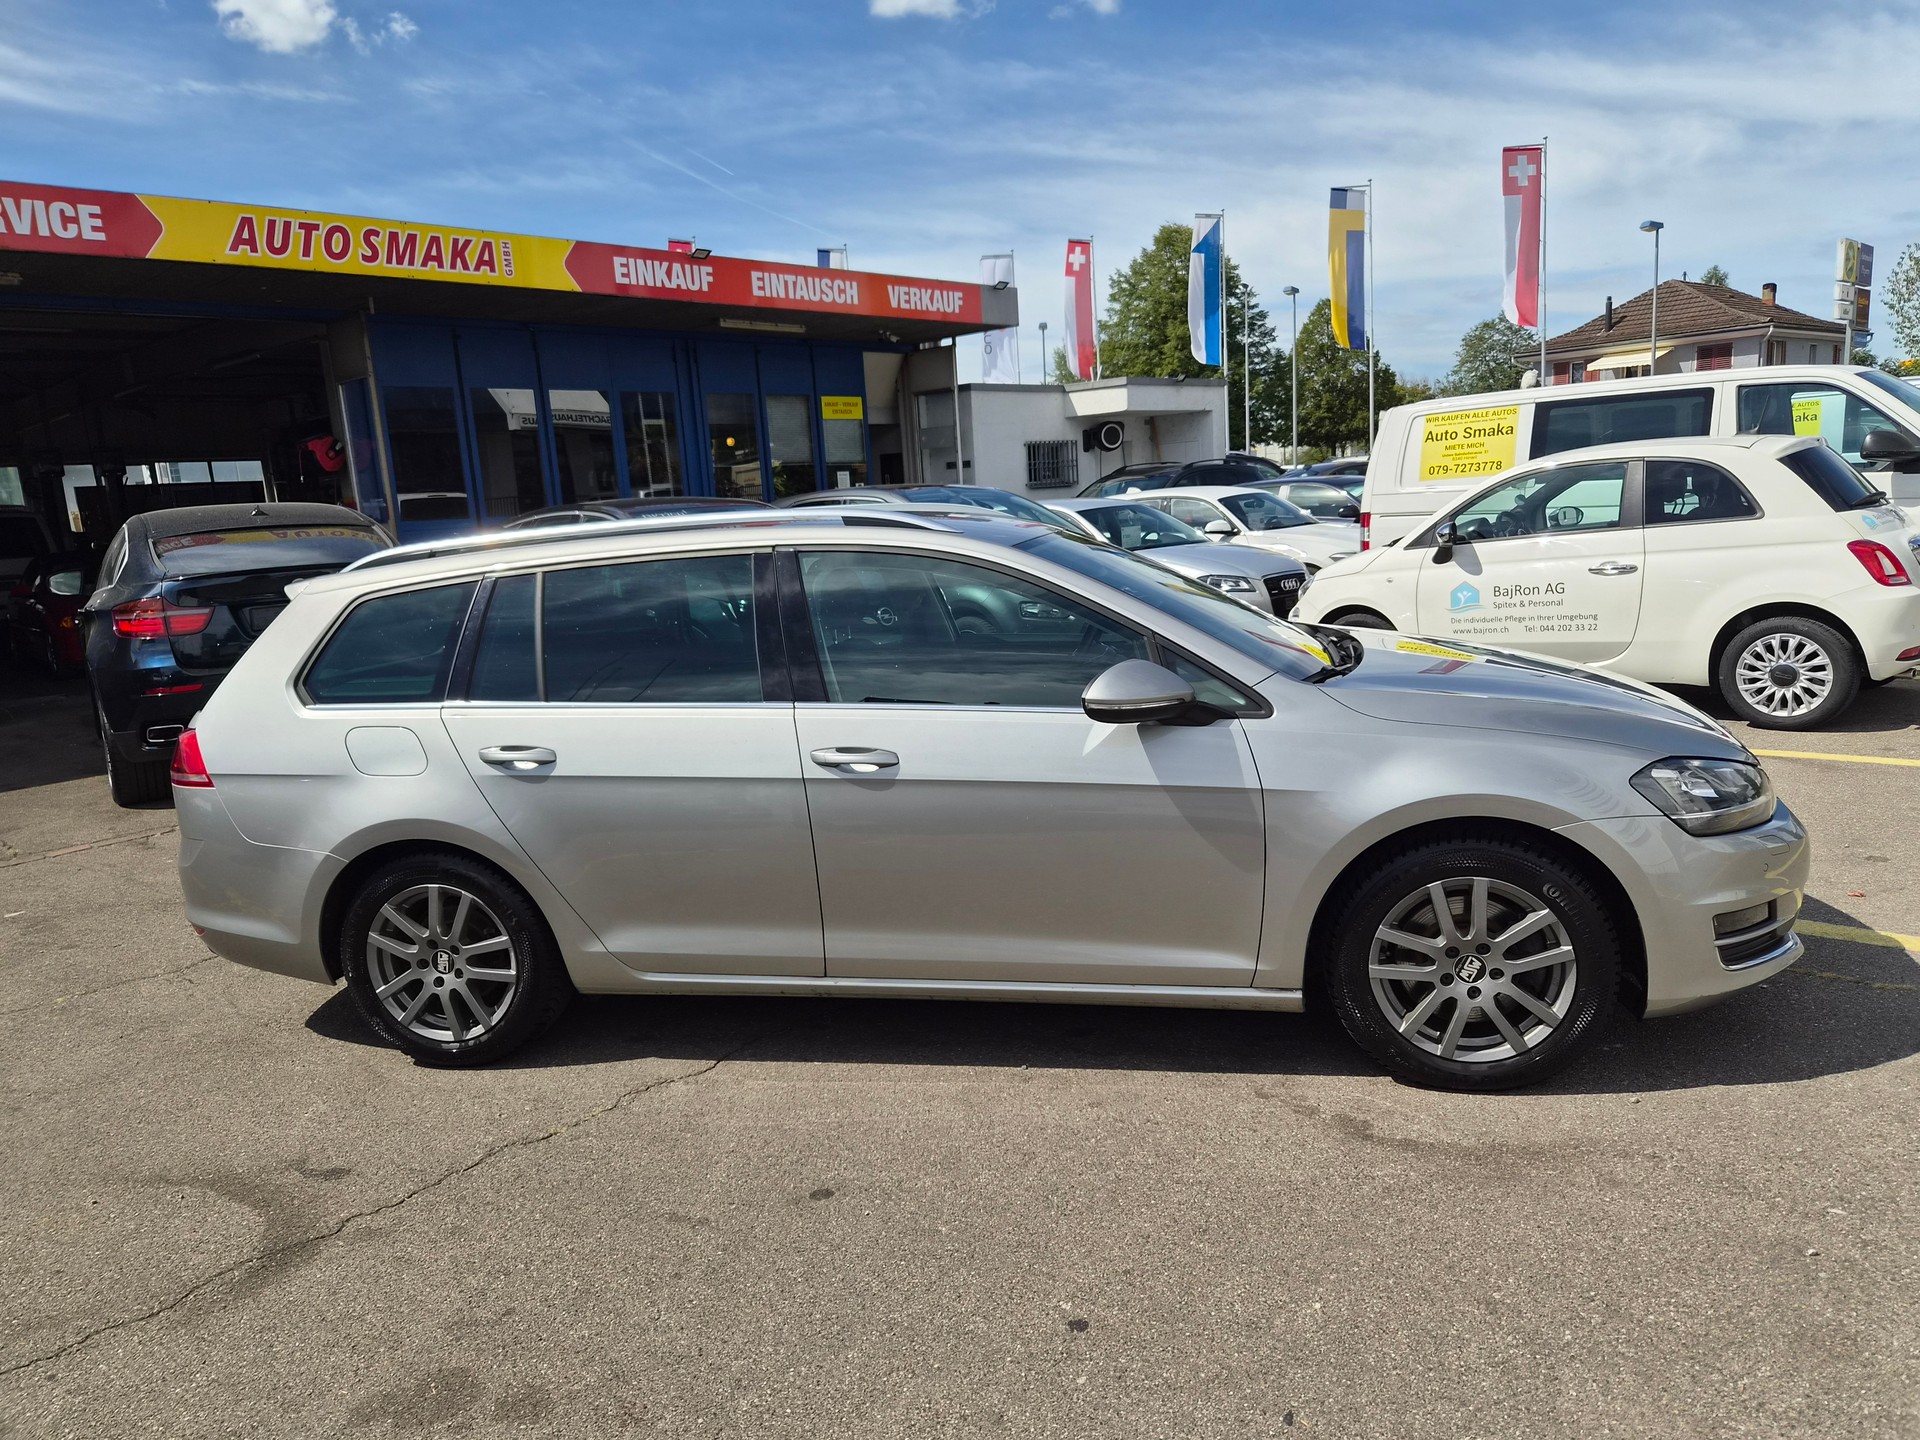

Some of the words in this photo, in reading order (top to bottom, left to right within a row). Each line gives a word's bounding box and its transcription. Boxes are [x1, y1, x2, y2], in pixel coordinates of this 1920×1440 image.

[227, 215, 352, 262] AUTO
[360, 227, 498, 275] SMAKA
[501, 240, 514, 277] GMBH
[613, 256, 713, 292] EINKAUF
[751, 271, 859, 305] EINTAUSCH
[887, 284, 963, 314] VERKAUF
[1426, 416, 1440, 424] WIR
[1441, 413, 1470, 422] KAUFEN
[1471, 410, 1490, 419] ALLE
[1491, 408, 1517, 417] AUTOS
[1424, 429, 1458, 443] Auto
[1462, 423, 1514, 439] Smaka
[1444, 443, 1465, 451] MIETE
[1466, 442, 1485, 450] MICH
[1428, 460, 1503, 476] 079-7273778
[1493, 584, 1540, 599] BajRon
[1545, 582, 1565, 595] AG
[1493, 601, 1517, 610] Spitex
[1519, 600, 1525, 608] &
[1528, 598, 1564, 607] Personal
[1463, 615, 1503, 623] individuelle
[1504, 614, 1527, 623] Pflege
[1556, 613, 1598, 622] Umgebung
[1452, 626, 1509, 635] www.bajron.ch
[1524, 625, 1538, 633] Tel:
[1539, 624, 1555, 632] 044
[1557, 624, 1572, 632] 202
[1575, 623, 1586, 631] 33
[1587, 623, 1598, 631] 22
